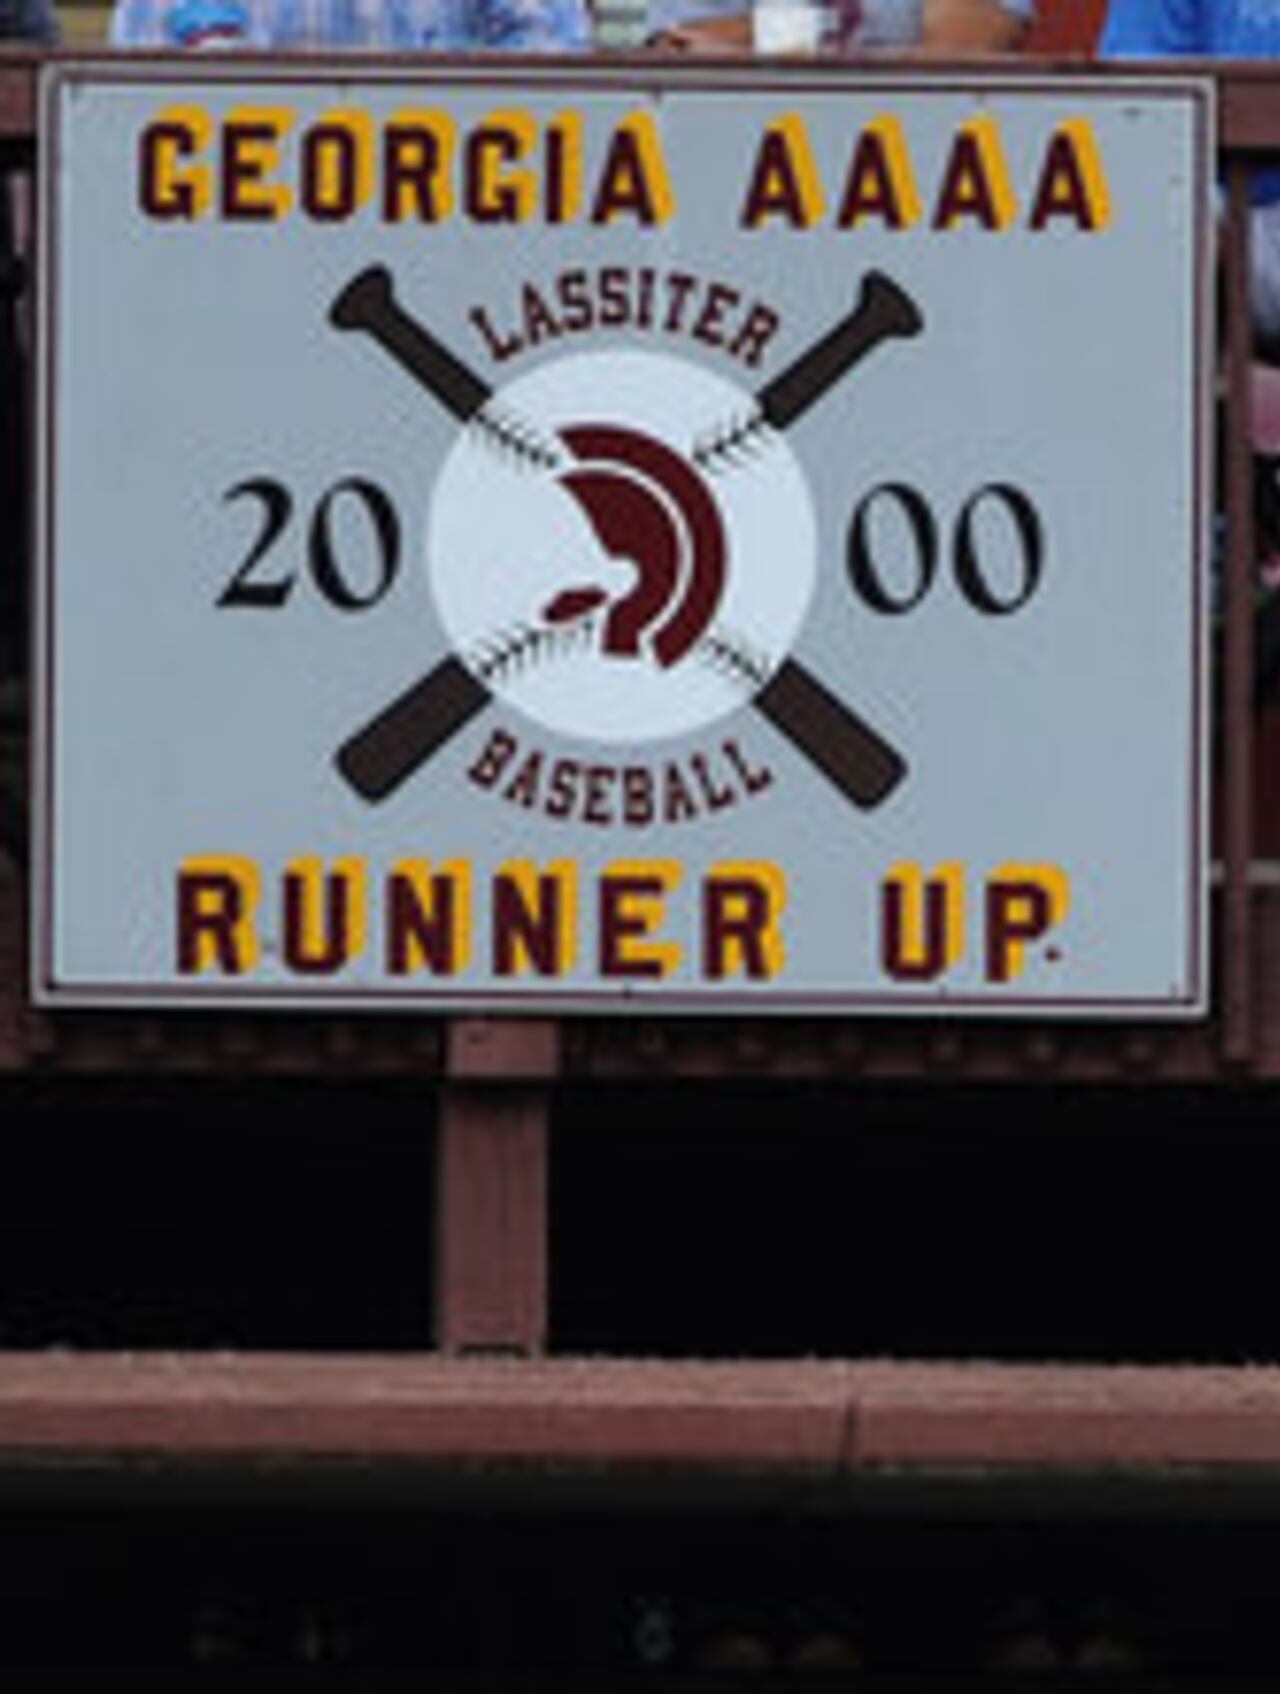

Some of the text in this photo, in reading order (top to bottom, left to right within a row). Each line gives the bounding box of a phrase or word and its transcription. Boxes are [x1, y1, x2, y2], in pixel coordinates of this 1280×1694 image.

[136, 103, 1113, 234] GEORGIA AAAA
[469, 266, 780, 368] LASSITER
[214, 476, 1045, 617] 20 00
[467, 729, 774, 825] BASEBALL
[174, 852, 1069, 985] RUNNER UP
